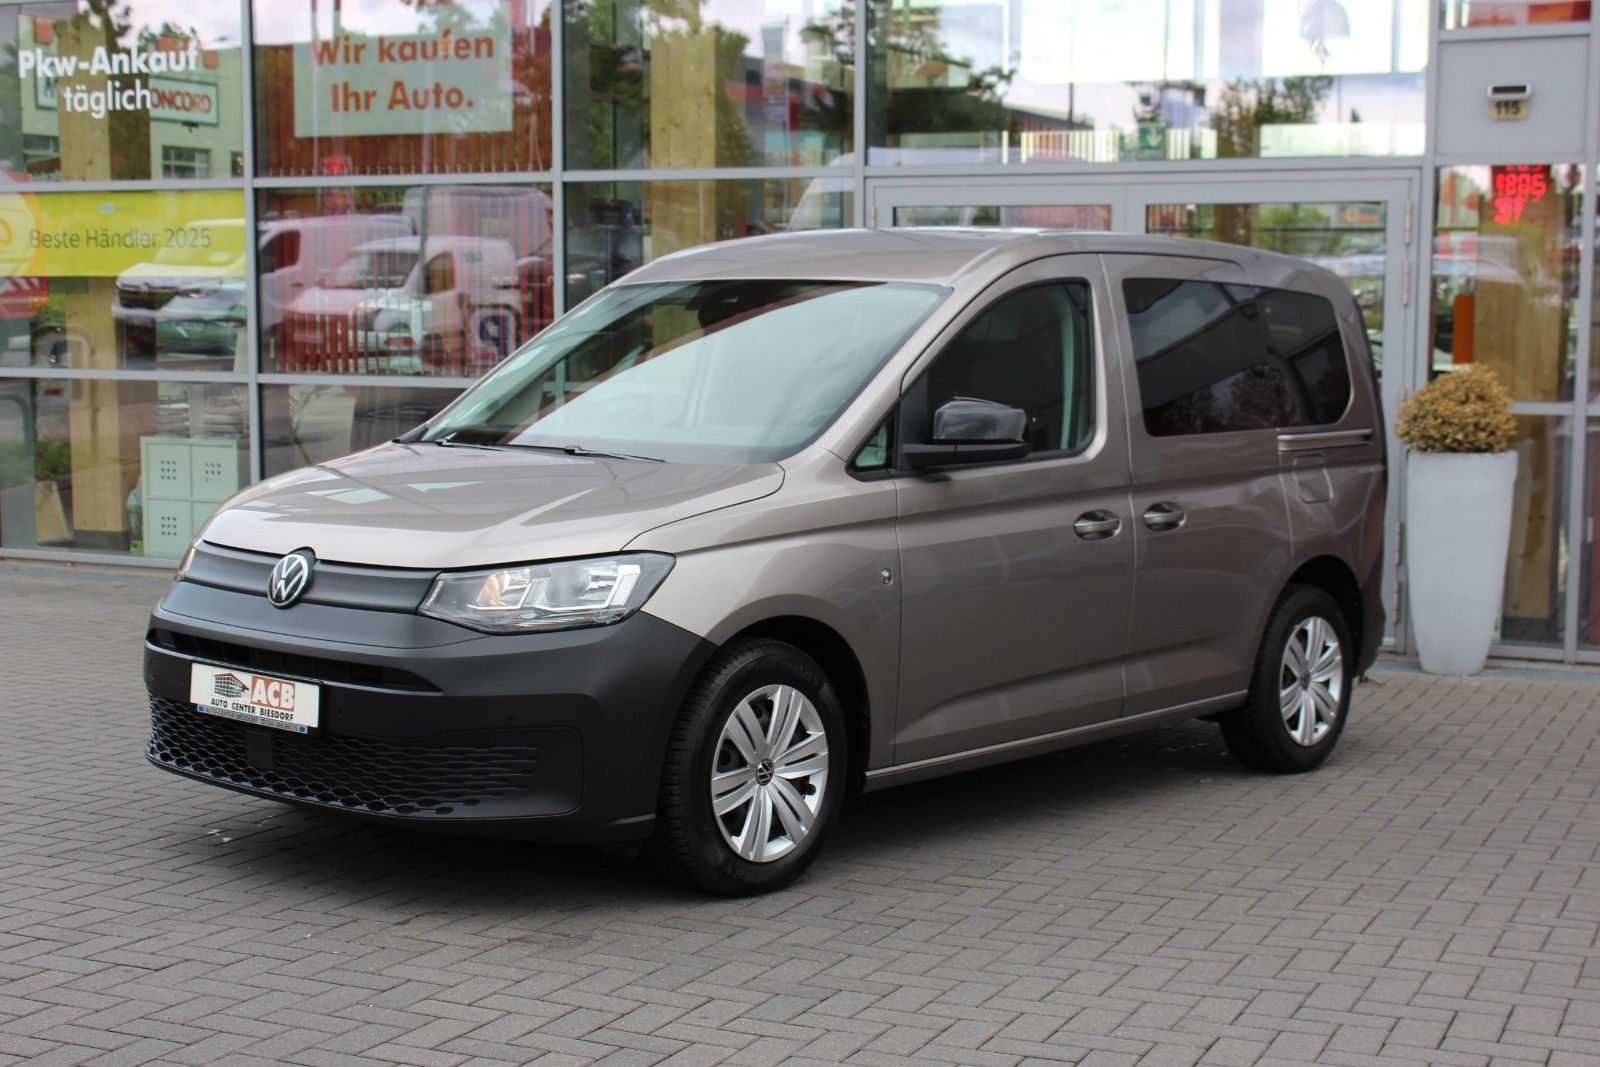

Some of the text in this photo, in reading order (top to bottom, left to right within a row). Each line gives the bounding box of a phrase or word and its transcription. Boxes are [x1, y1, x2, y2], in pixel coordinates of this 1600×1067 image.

[18, 41, 197, 78] Pkw-Ankauf
[313, 29, 494, 65] Wir kaufen
[64, 78, 151, 119] täglich
[331, 80, 474, 112] Ihr Auto.
[1495, 100, 1520, 115] 115
[30, 228, 211, 248] Beste Händler 2025
[252, 679, 294, 708] ACB
[211, 698, 294, 721] AUTO CENTER BIESDORF
